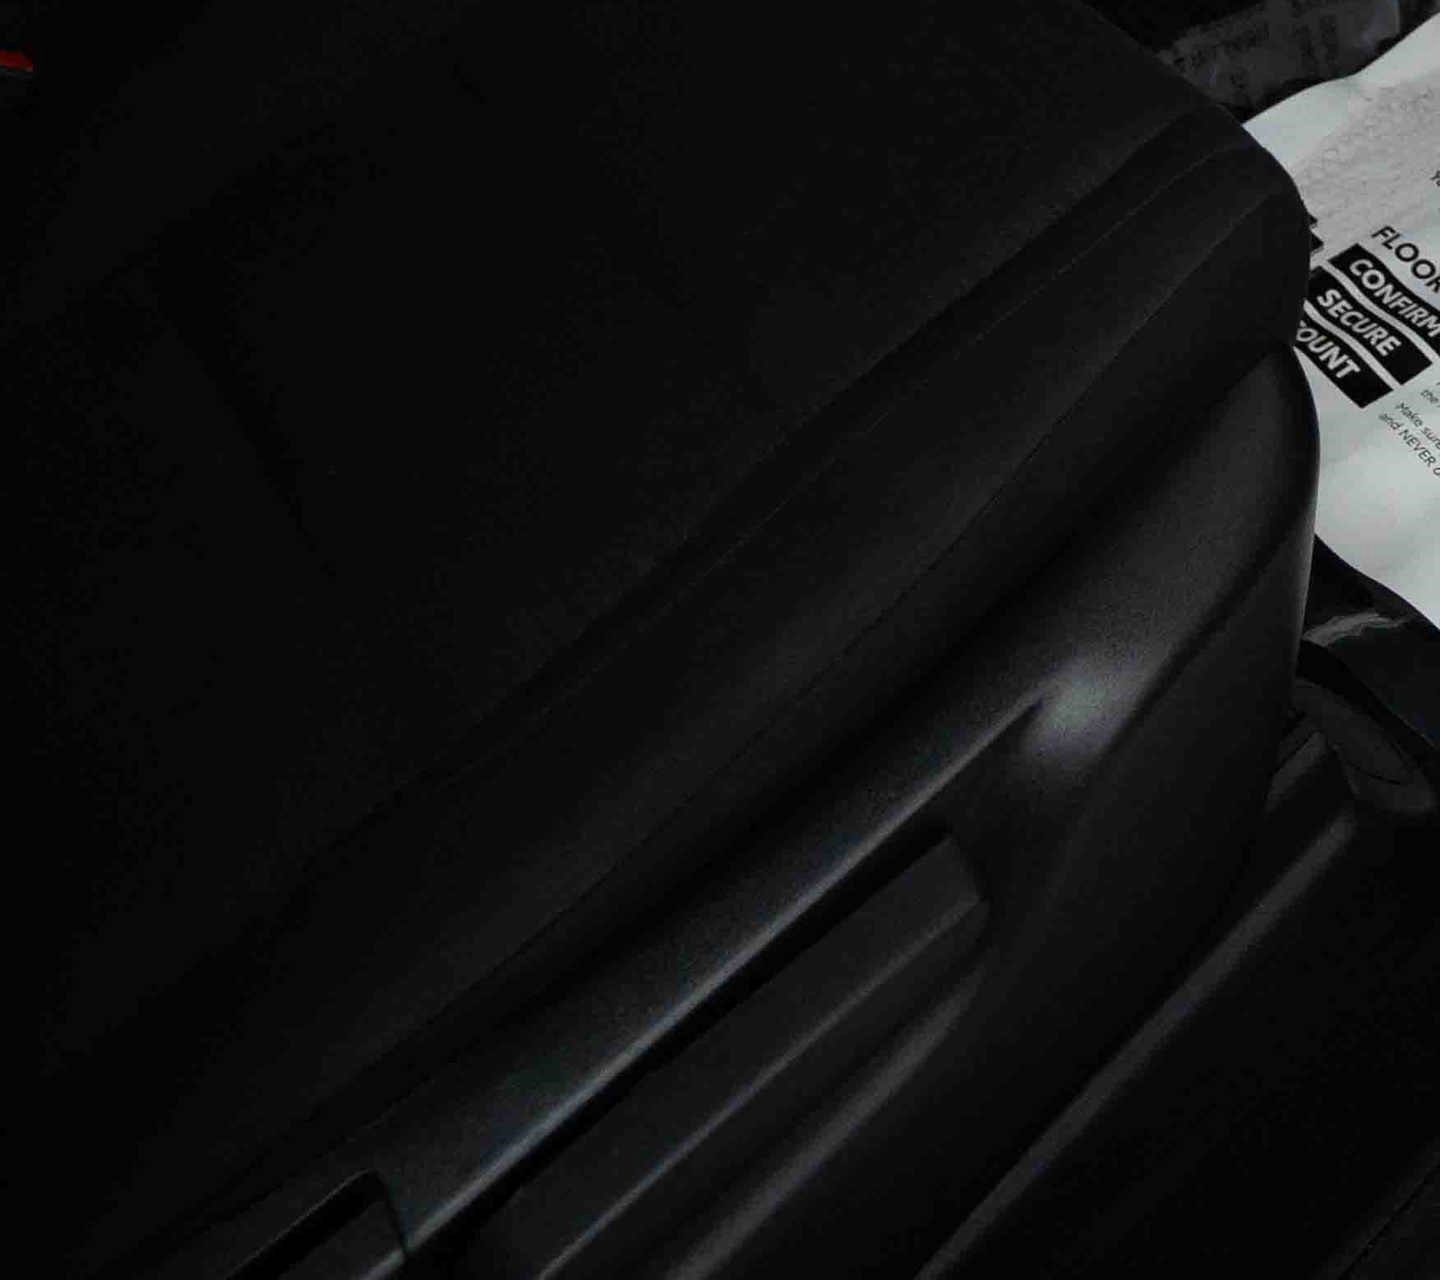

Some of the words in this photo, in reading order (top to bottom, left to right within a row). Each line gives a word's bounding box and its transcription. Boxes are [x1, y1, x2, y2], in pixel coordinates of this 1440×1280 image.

[1296, 320, 1361, 378] OUNT
[1316, 288, 1402, 358] SECURE
[1398, 429, 1437, 468] NEVER
